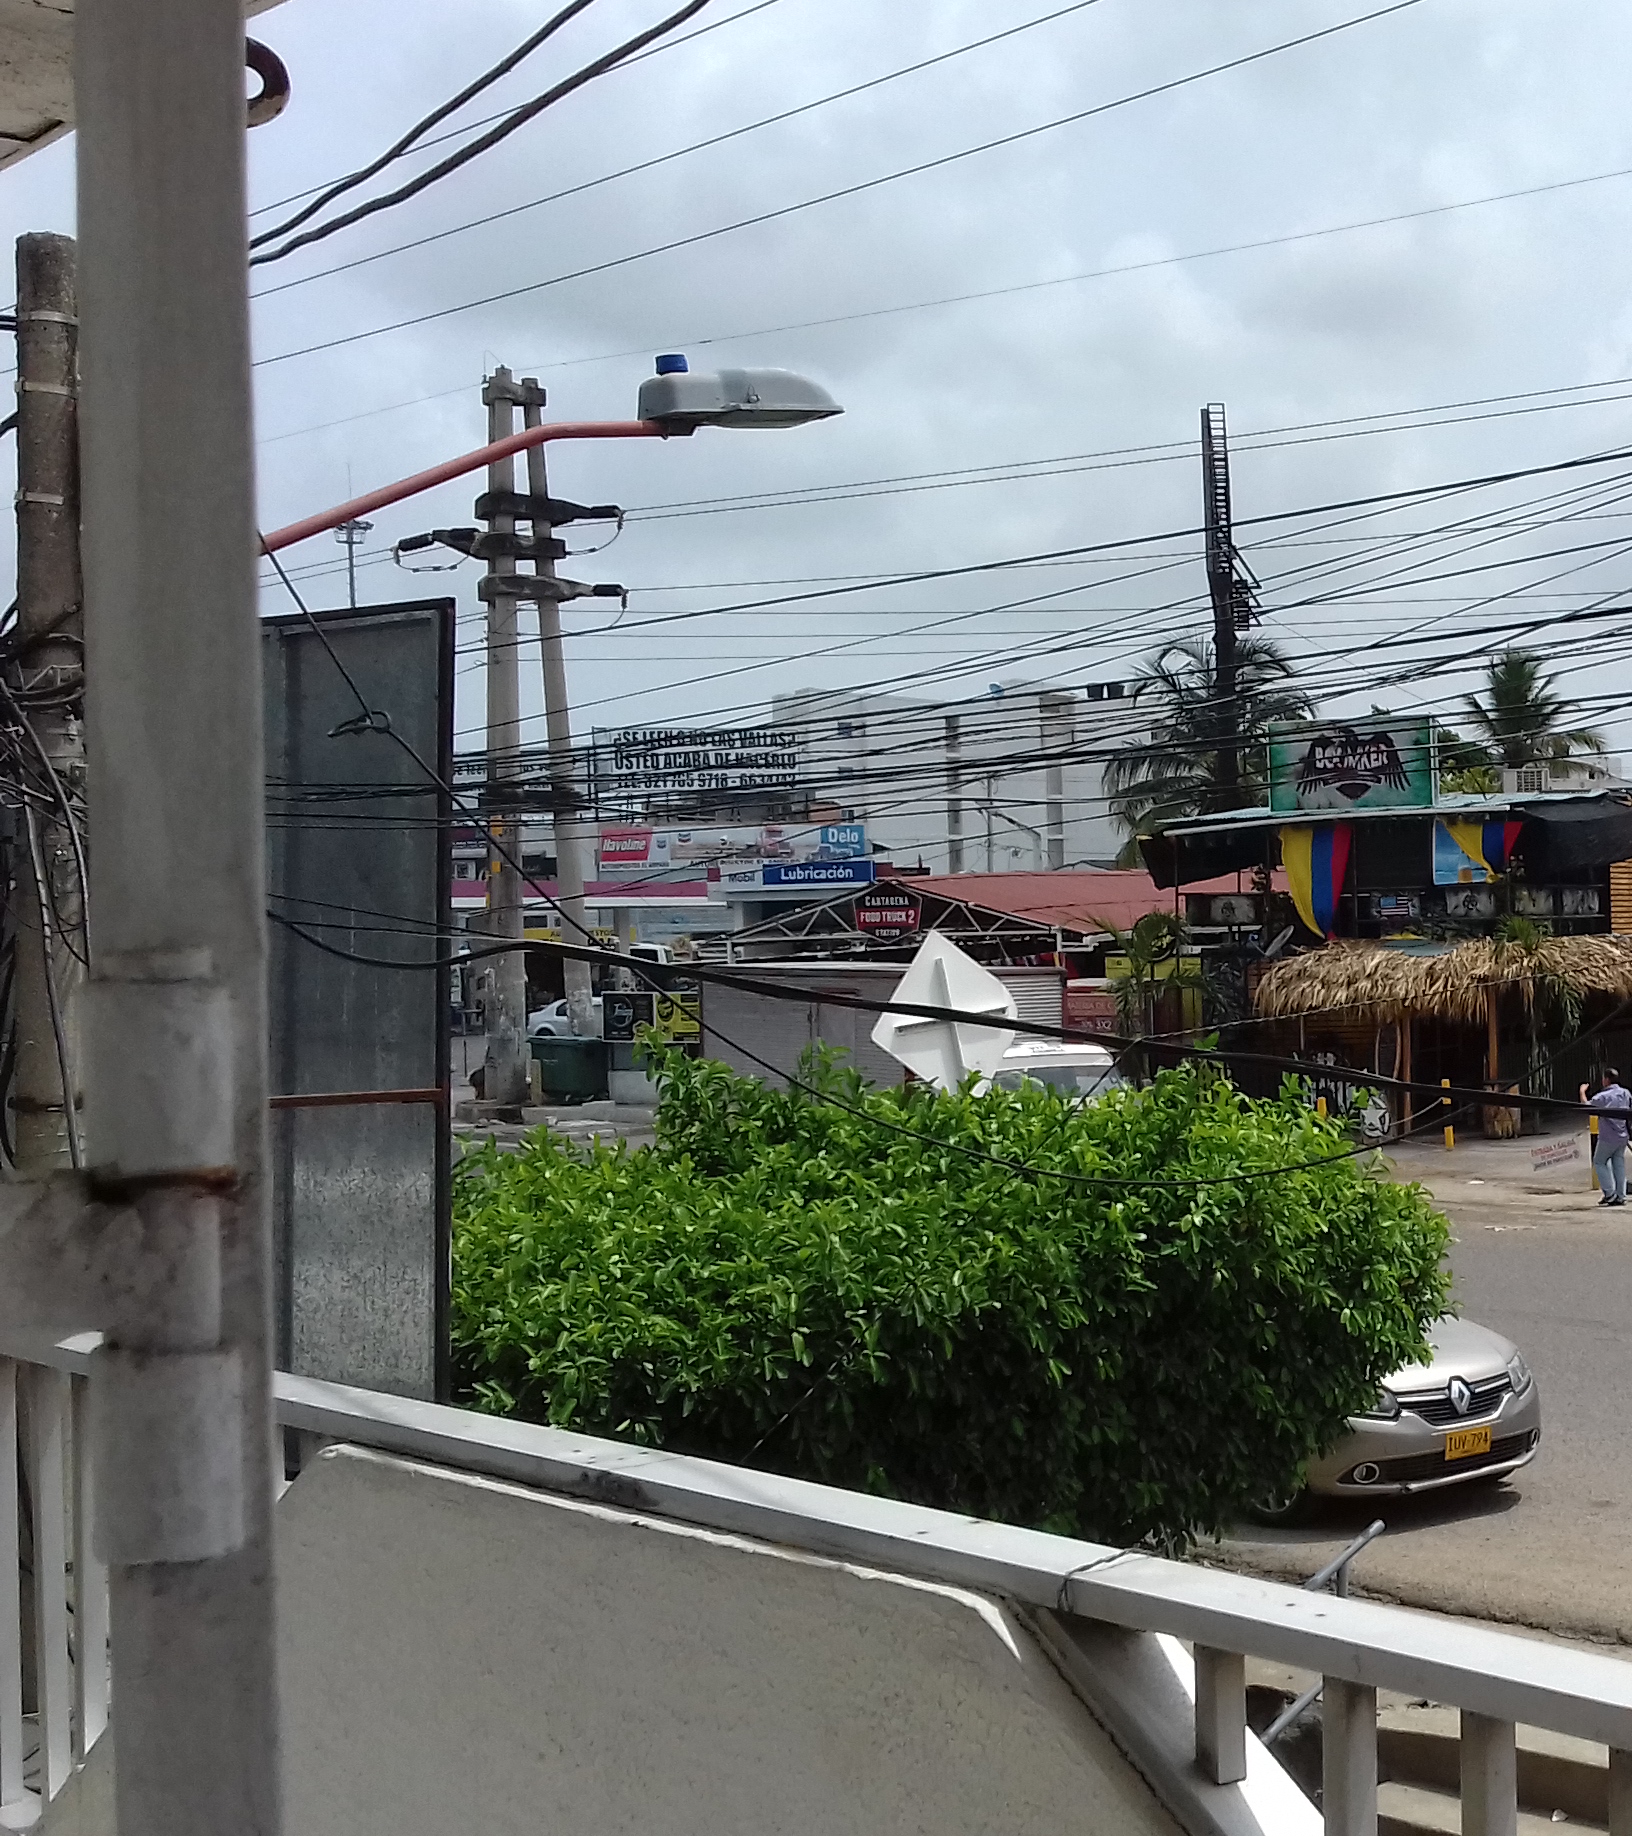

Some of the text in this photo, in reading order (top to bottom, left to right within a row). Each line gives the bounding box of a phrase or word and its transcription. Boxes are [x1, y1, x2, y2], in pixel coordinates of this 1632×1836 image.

[828, 828, 859, 843] Delo
[602, 838, 647, 852] Havoline
[780, 864, 854, 881] Lubricación
[864, 896, 909, 906] CARTAGENA
[860, 909, 916, 924] FOOD TRUCK 2
